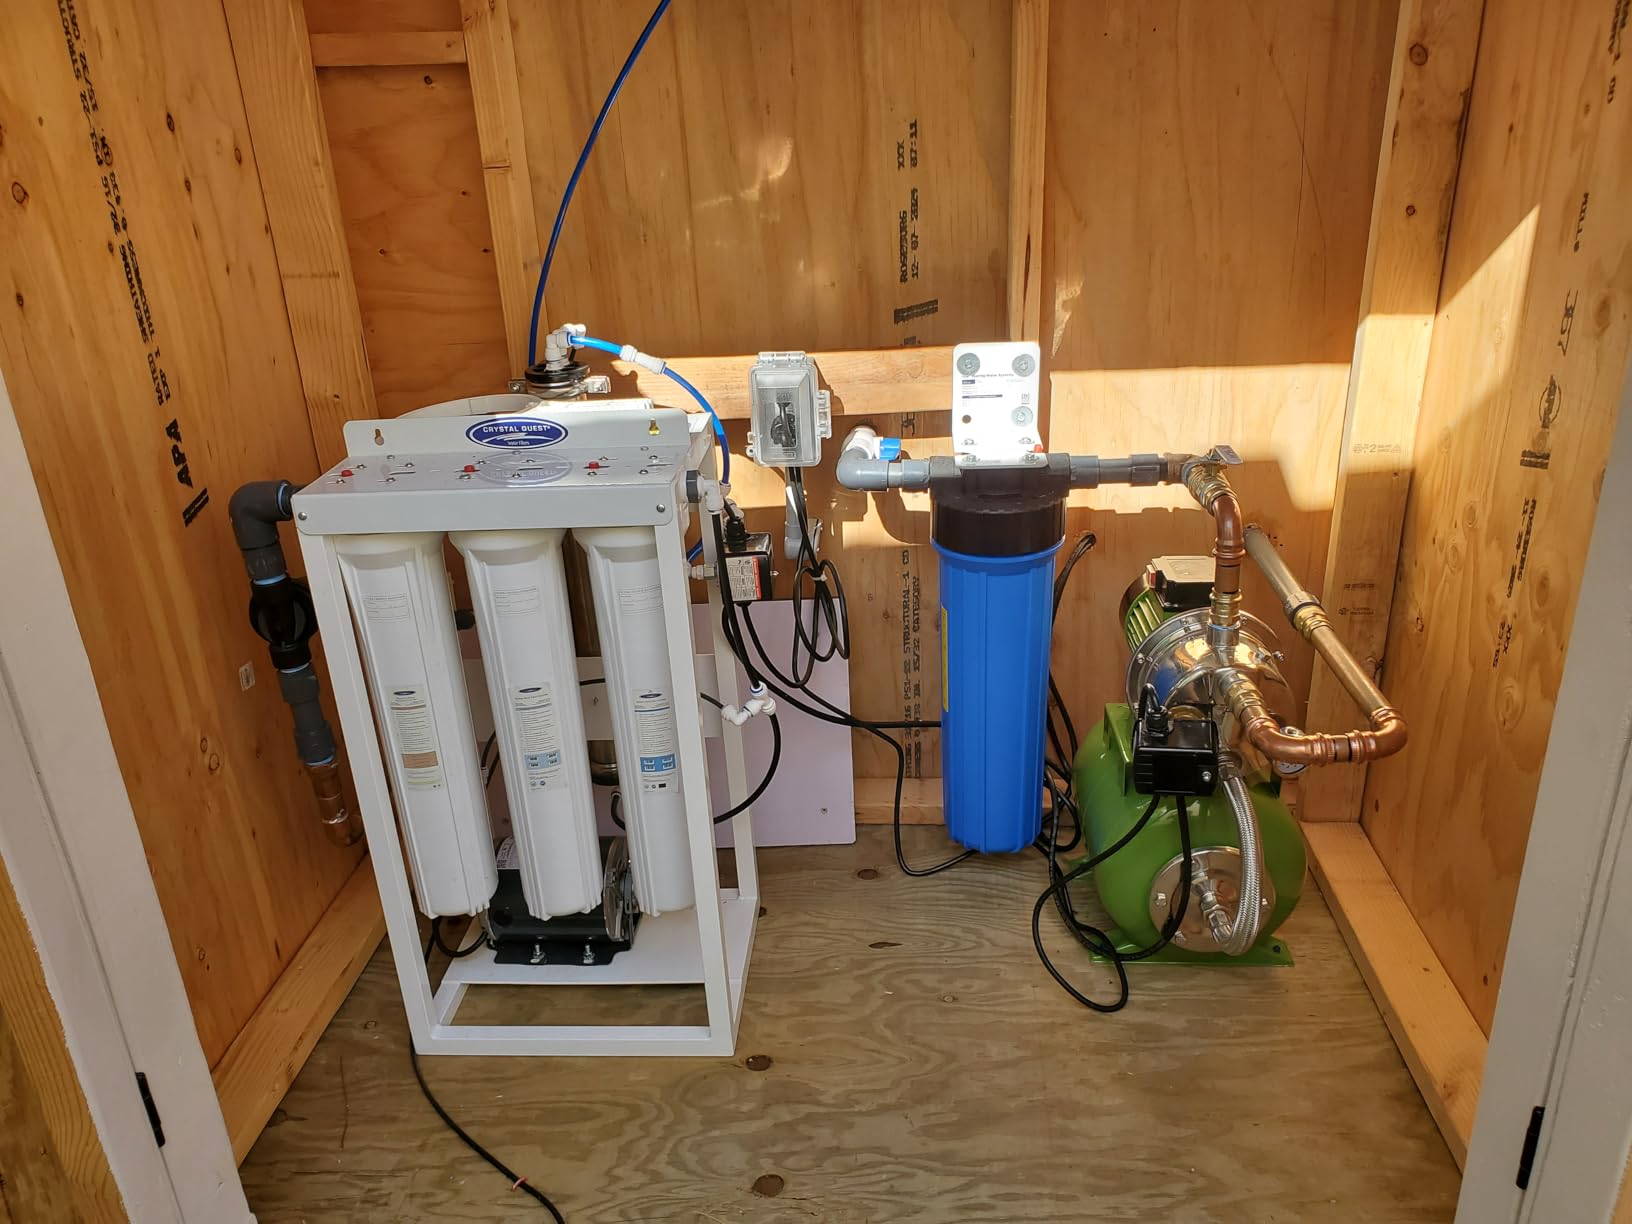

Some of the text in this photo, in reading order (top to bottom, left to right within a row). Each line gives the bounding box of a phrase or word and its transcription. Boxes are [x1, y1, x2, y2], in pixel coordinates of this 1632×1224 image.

[80, 51, 98, 112] 15/32
[899, 209, 908, 284] ROSEBURG
[119, 244, 149, 344] SHEATHING
[126, 239, 155, 341] THICKNESS
[147, 353, 164, 406] RATED
[165, 418, 194, 489] APA
[912, 576, 920, 632] CATEGORY
